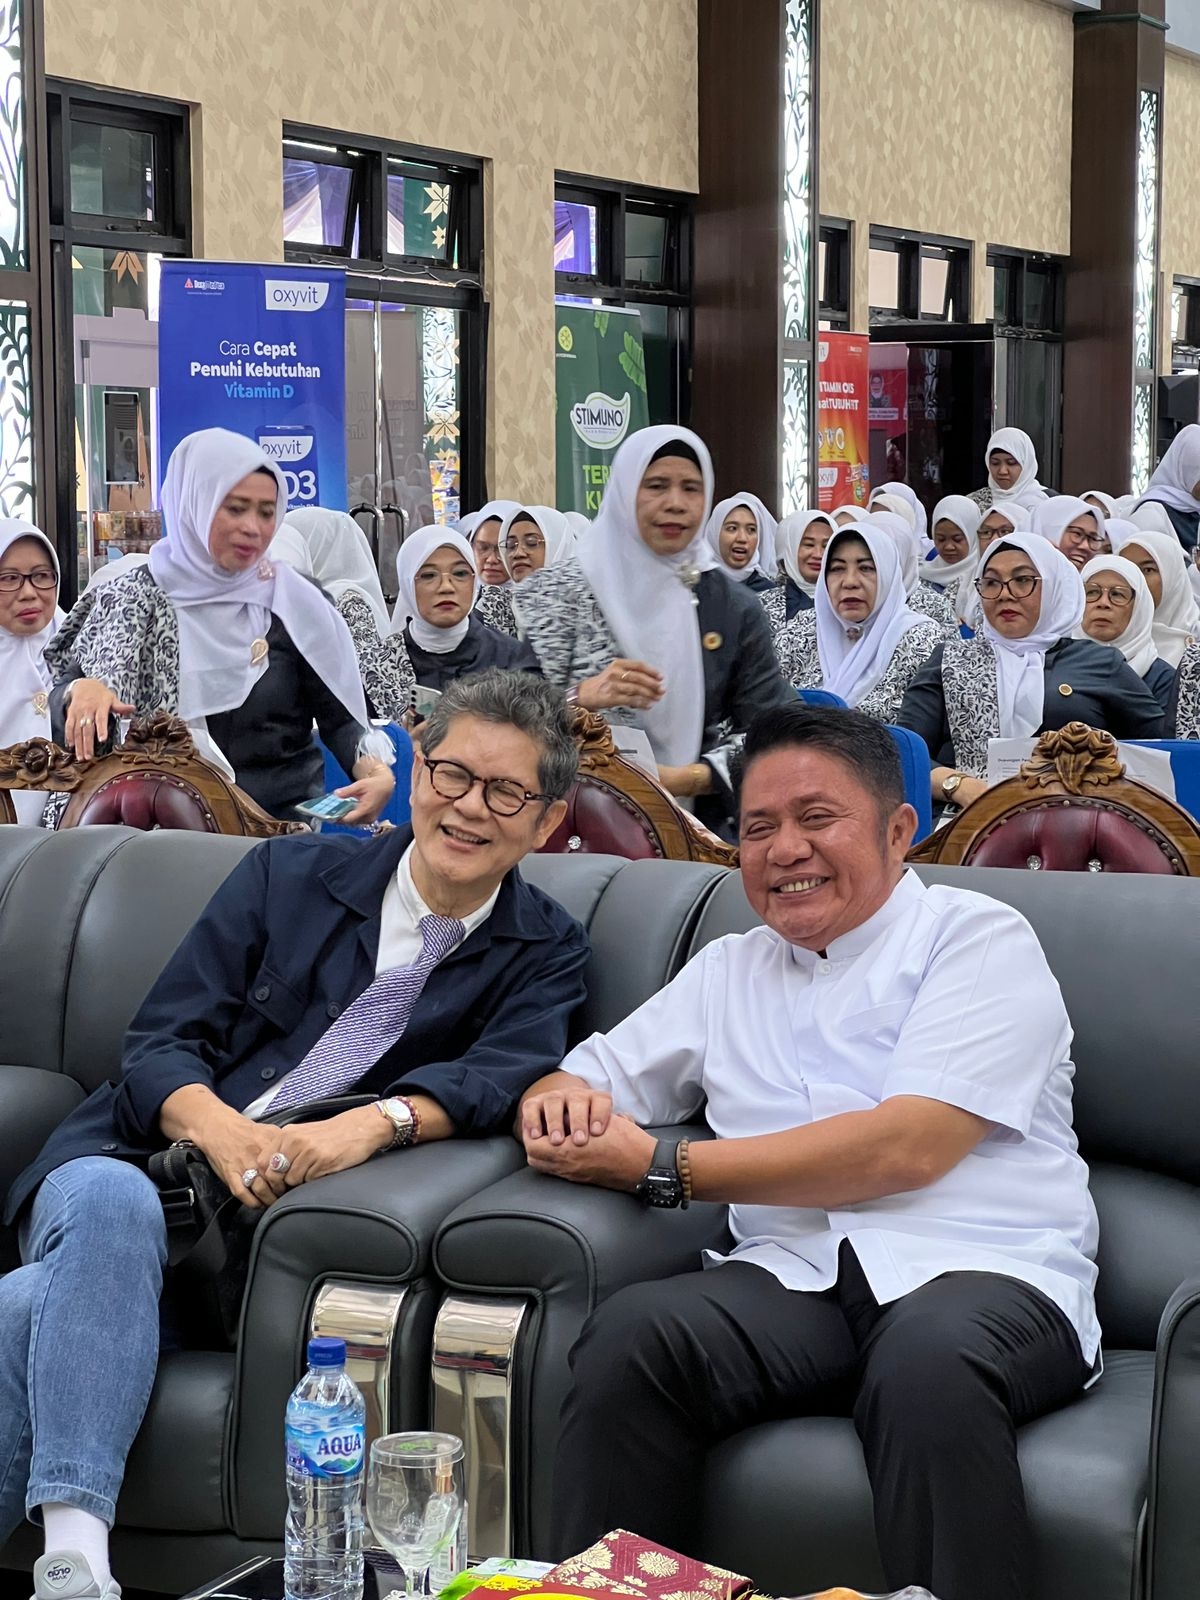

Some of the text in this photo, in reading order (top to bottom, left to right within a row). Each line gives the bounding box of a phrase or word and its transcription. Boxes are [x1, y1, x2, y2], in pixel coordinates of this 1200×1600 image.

[273, 286, 318, 307] oxyvit
[219, 340, 297, 359] Cara Cepat
[190, 359, 321, 378] Penuhi Kebutuhan
[224, 382, 294, 399] Vitamin D
[575, 408, 623, 426] STIMUNO
[262, 439, 302, 458] oxyvit
[582, 465, 613, 484] TER
[281, 470, 317, 500] D3
[317, 1433, 362, 1456] AQUA
